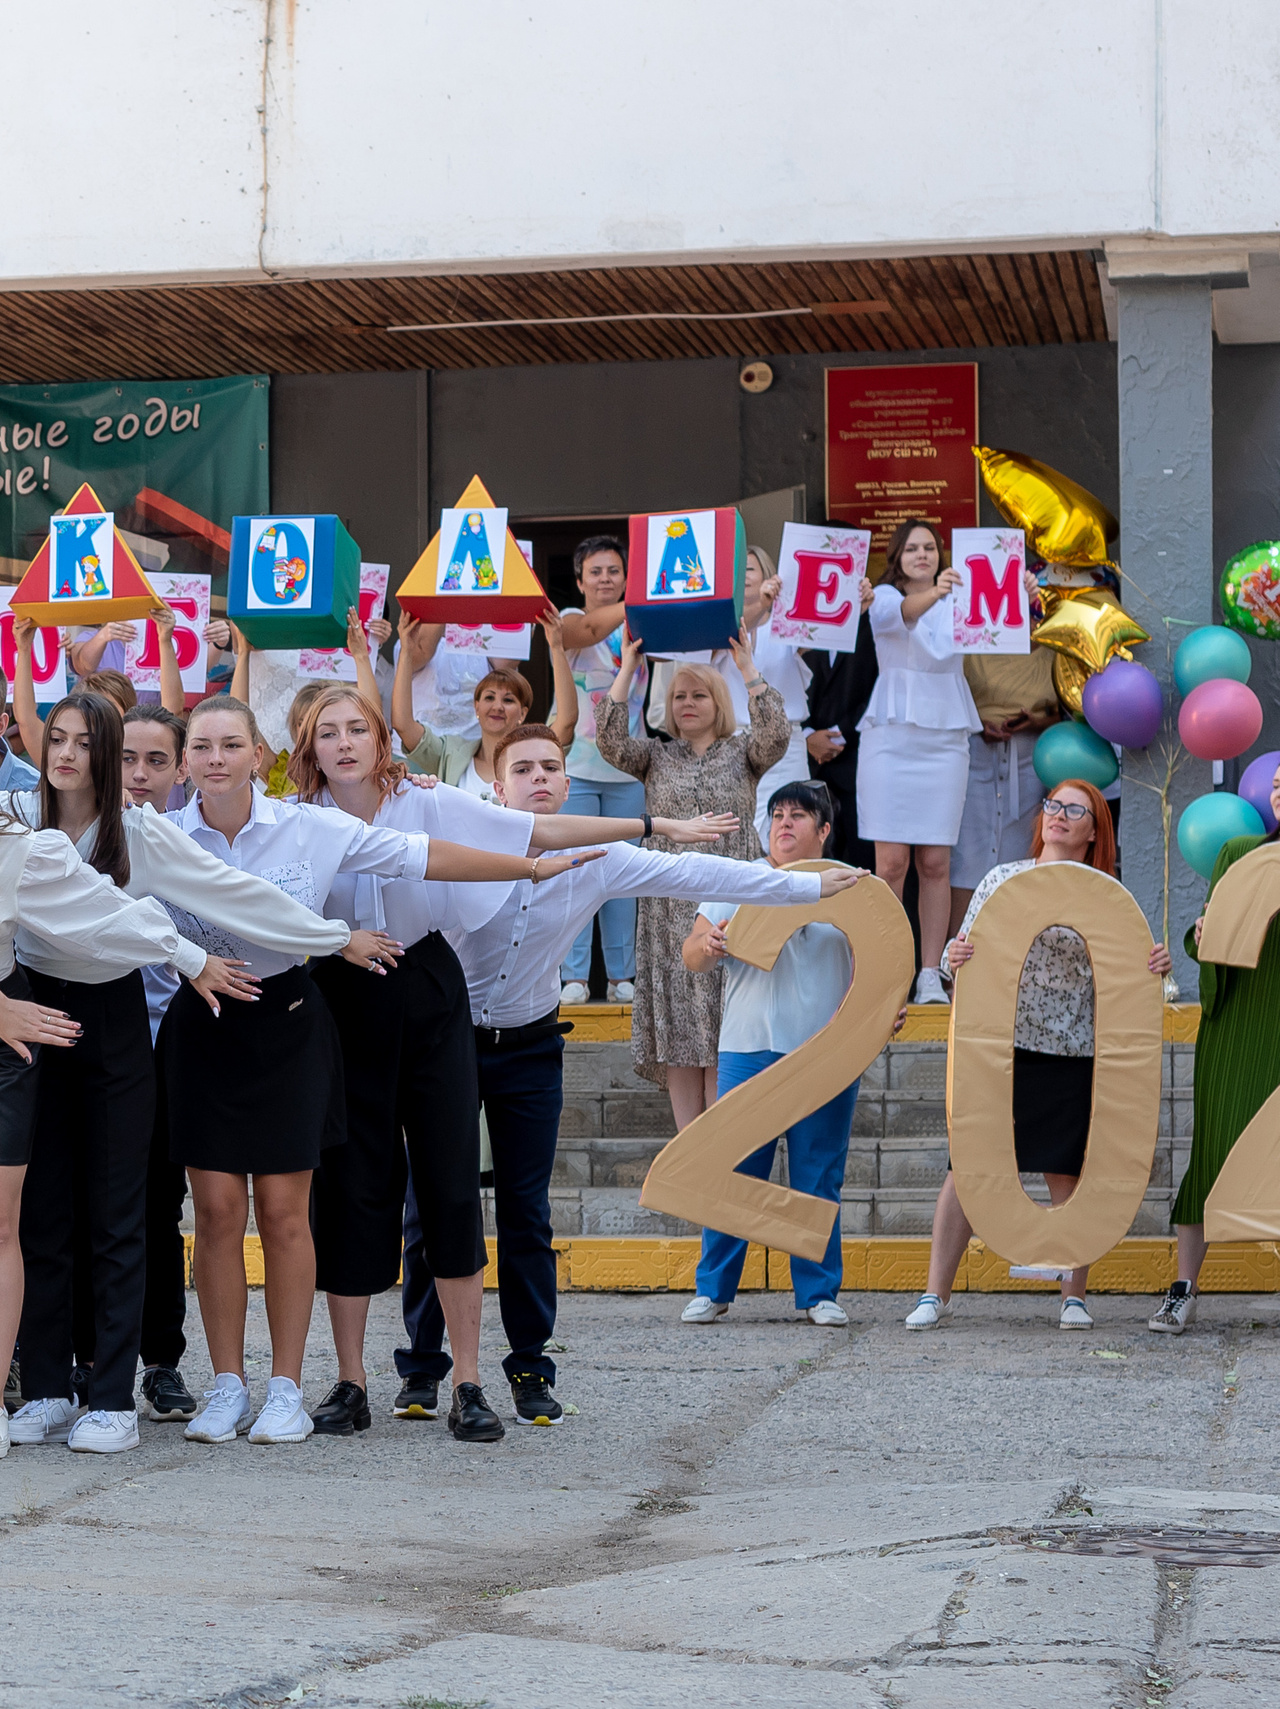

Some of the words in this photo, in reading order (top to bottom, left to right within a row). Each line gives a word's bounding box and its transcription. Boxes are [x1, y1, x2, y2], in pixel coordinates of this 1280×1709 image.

[93, 397, 201, 443] годы
[867, 449, 892, 459] (МОУ
[893, 448, 911, 458] СШ
[923, 447, 937, 458] 27)
[786, 550, 854, 627] Е
[965, 554, 1024, 629] М
